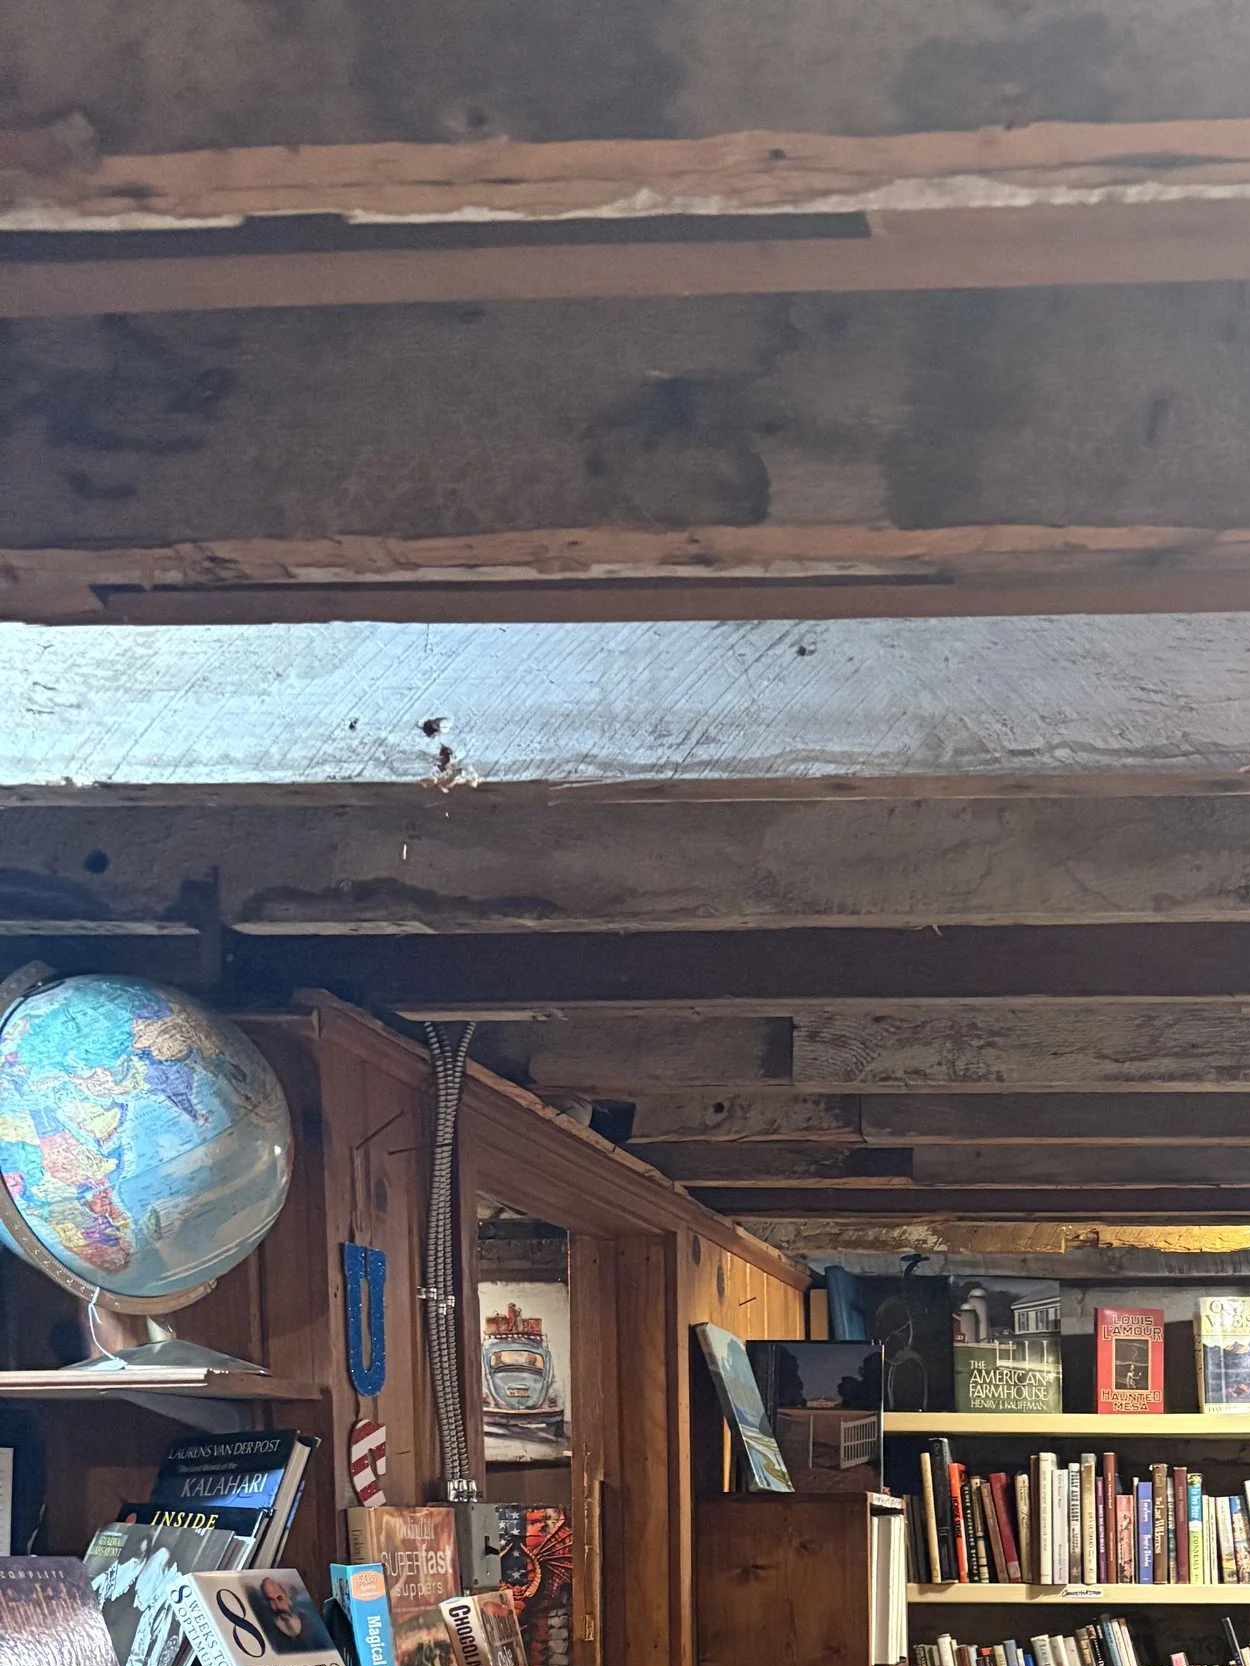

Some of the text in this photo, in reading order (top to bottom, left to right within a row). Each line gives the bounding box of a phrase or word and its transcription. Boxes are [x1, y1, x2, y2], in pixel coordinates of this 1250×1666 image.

[1112, 1316, 1154, 1326] LOUIS
[1102, 1326, 1163, 1341] L'AMOUR
[970, 1360, 986, 1370] THE
[970, 1370, 1048, 1385] AMERICAN
[969, 1384, 1048, 1400] FARMHOUSE
[1101, 1391, 1161, 1402] HAUNTED
[971, 1400, 996, 1409] HENRY
[1114, 1402, 1149, 1412] MESA
[168, 1440, 280, 1460] LAURENS VAN DER POST
[180, 1473, 268, 1498] KALAHARI
[1070, 1470, 1080, 1522] FOLLY AND GLORY
[150, 1510, 219, 1530] INSIDE
[952, 1496, 964, 1539] HORSE SENSE
[1155, 1504, 1164, 1520] Last
[1154, 1520, 1164, 1554] Wilderness
[396, 1580, 444, 1596] suppers
[170, 1584, 193, 1605] 8
[188, 1600, 218, 1650] WEEKS
[216, 1588, 266, 1658] 8
[365, 1616, 382, 1664] Magical
